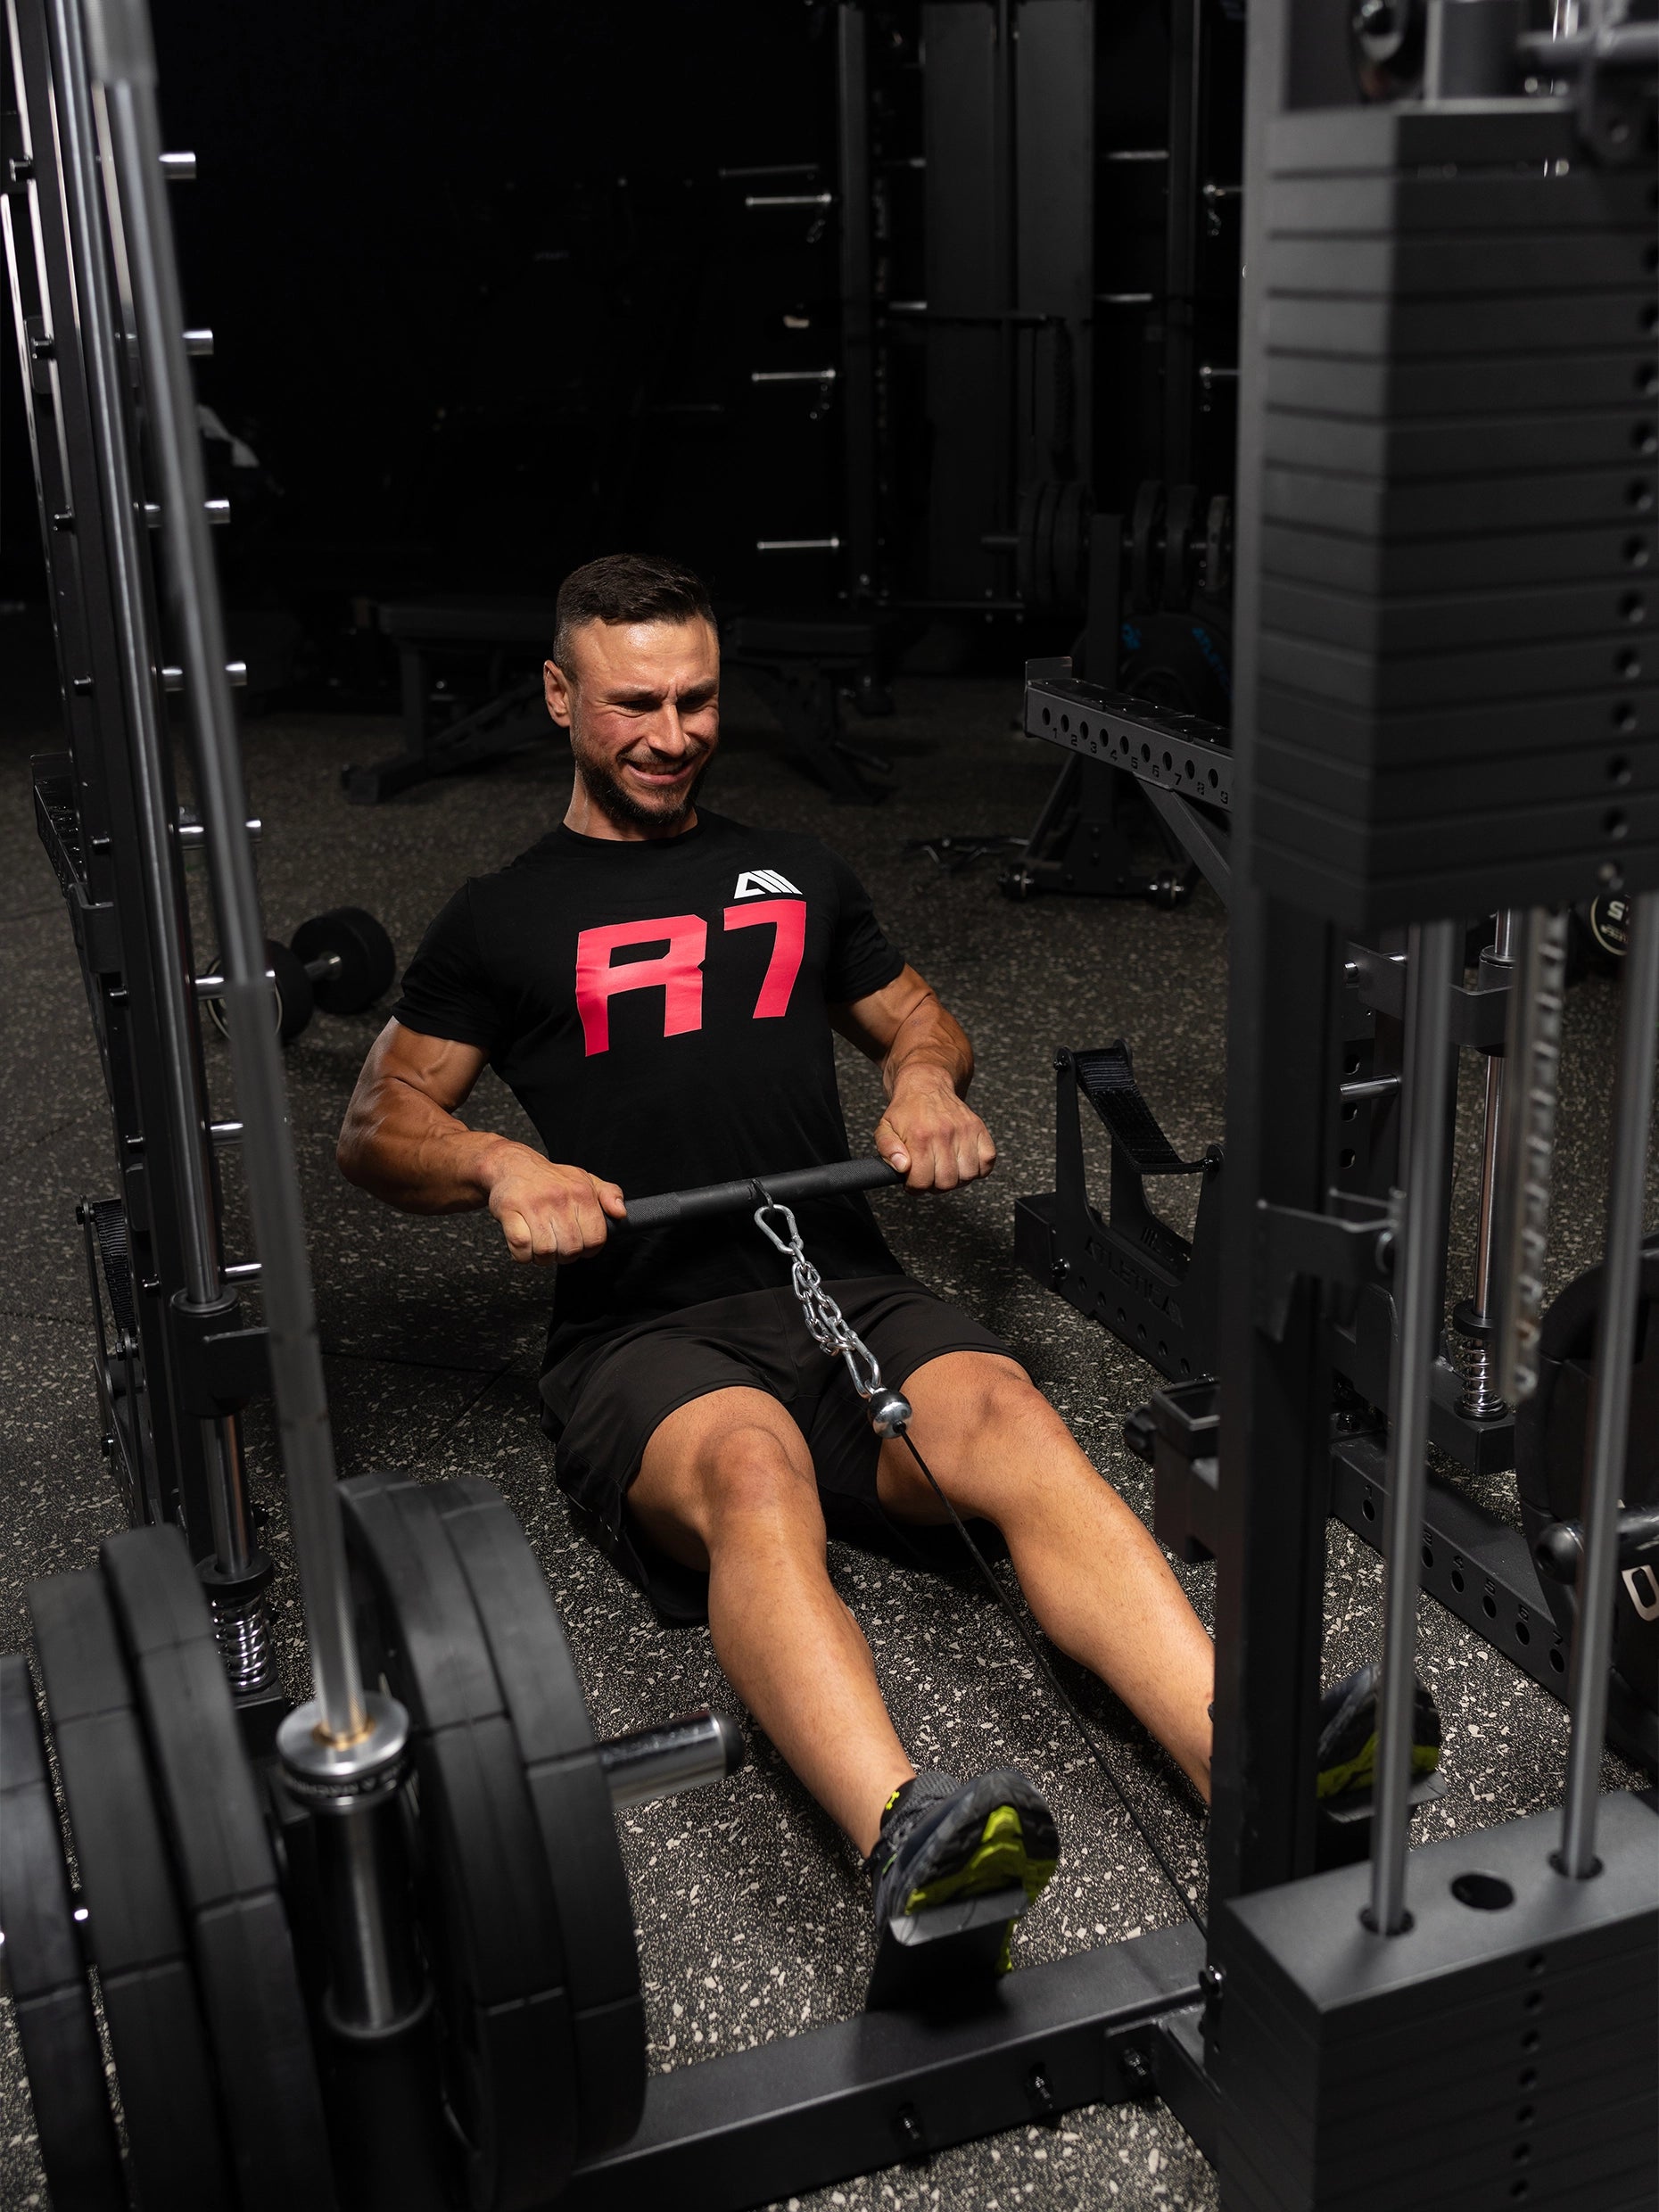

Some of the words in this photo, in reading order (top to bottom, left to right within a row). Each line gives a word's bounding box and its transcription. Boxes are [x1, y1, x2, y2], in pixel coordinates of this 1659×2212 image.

[1052, 727, 1058, 739] 1
[1071, 734, 1077, 747] 2
[1090, 741, 1097, 754] 3
[1110, 749, 1118, 761] 4
[1131, 756, 1138, 769] 5
[1152, 764, 1160, 778] 6
[1175, 772, 1182, 785] 7
[1197, 781, 1204, 795] 8
[575, 899, 806, 1057] R7
[1484, 1577, 1496, 1597] 5
[1517, 1603, 1529, 1622] 6
[1552, 1630, 1564, 1647] 7
